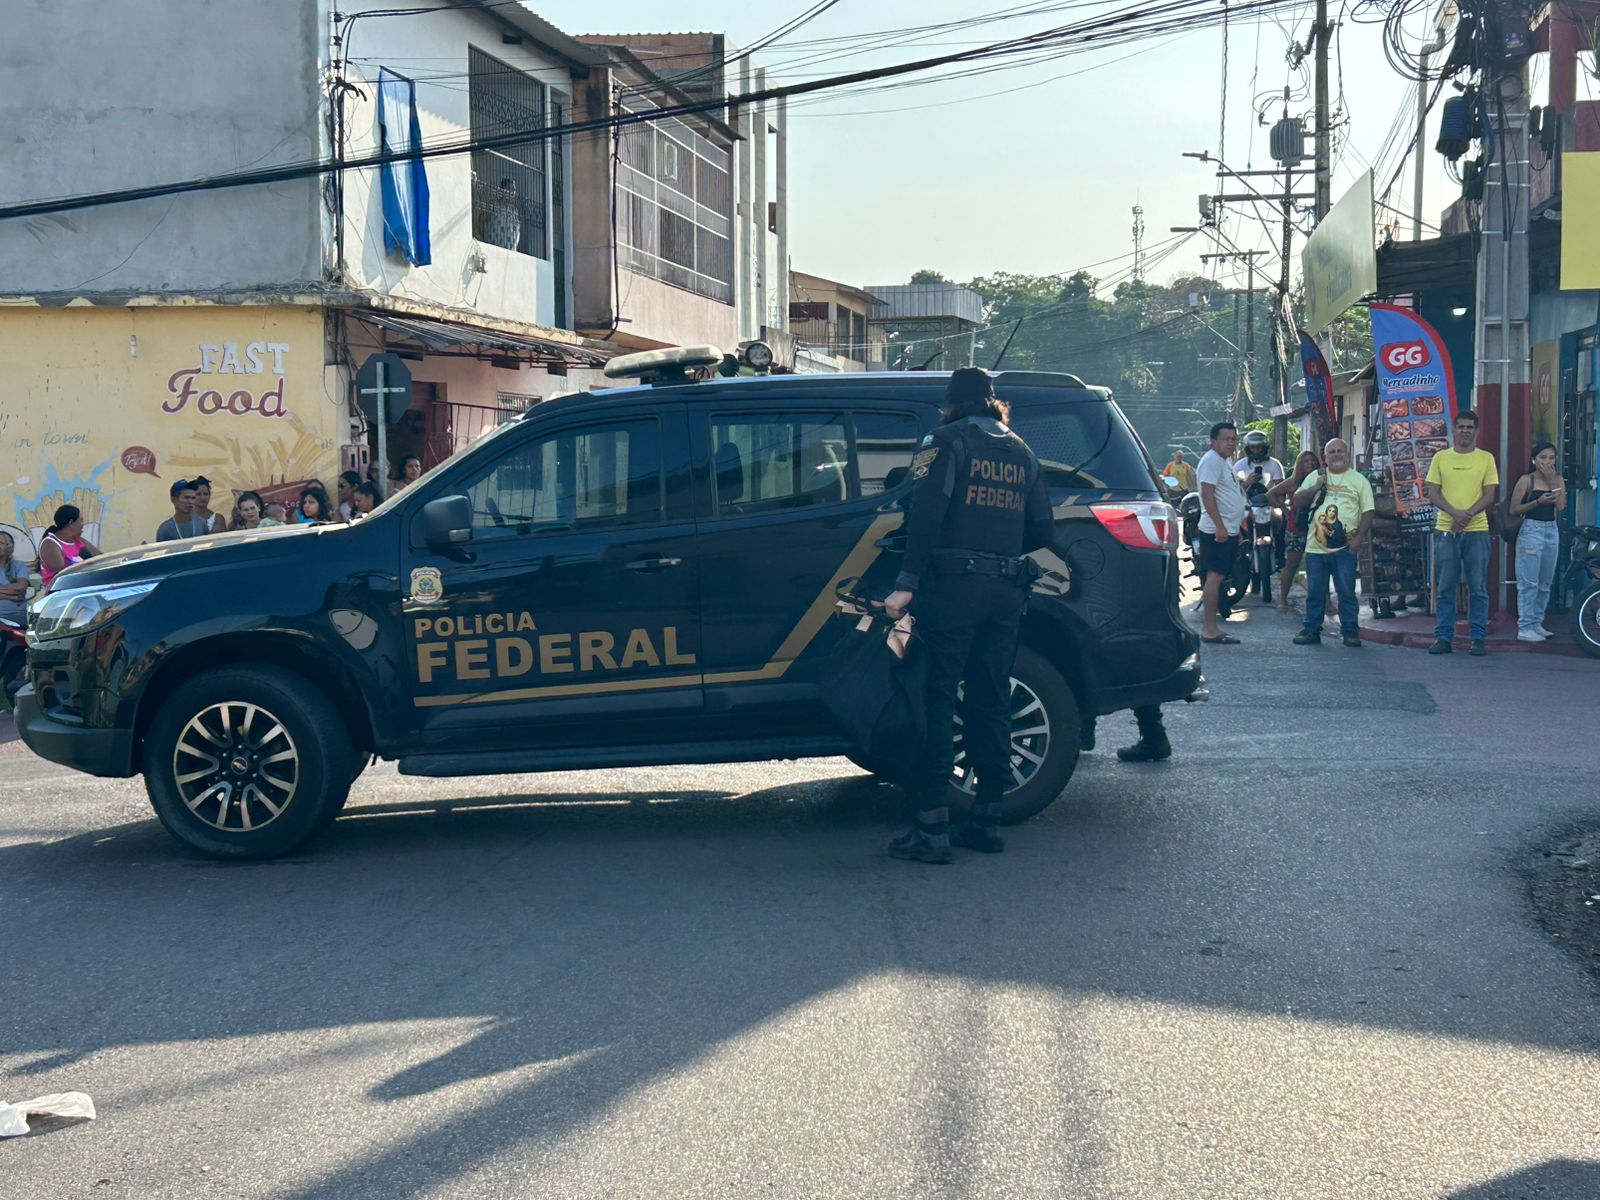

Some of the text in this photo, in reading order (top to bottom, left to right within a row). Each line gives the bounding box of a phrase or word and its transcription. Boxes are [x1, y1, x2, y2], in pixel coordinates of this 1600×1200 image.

[199, 341, 289, 374] FAST
[1387, 345, 1423, 367] GG
[161, 367, 288, 418] Food
[1383, 374, 1440, 388] Mercadinho
[970, 458, 1026, 485] POLICIA
[416, 626, 696, 683] FEDERAL
